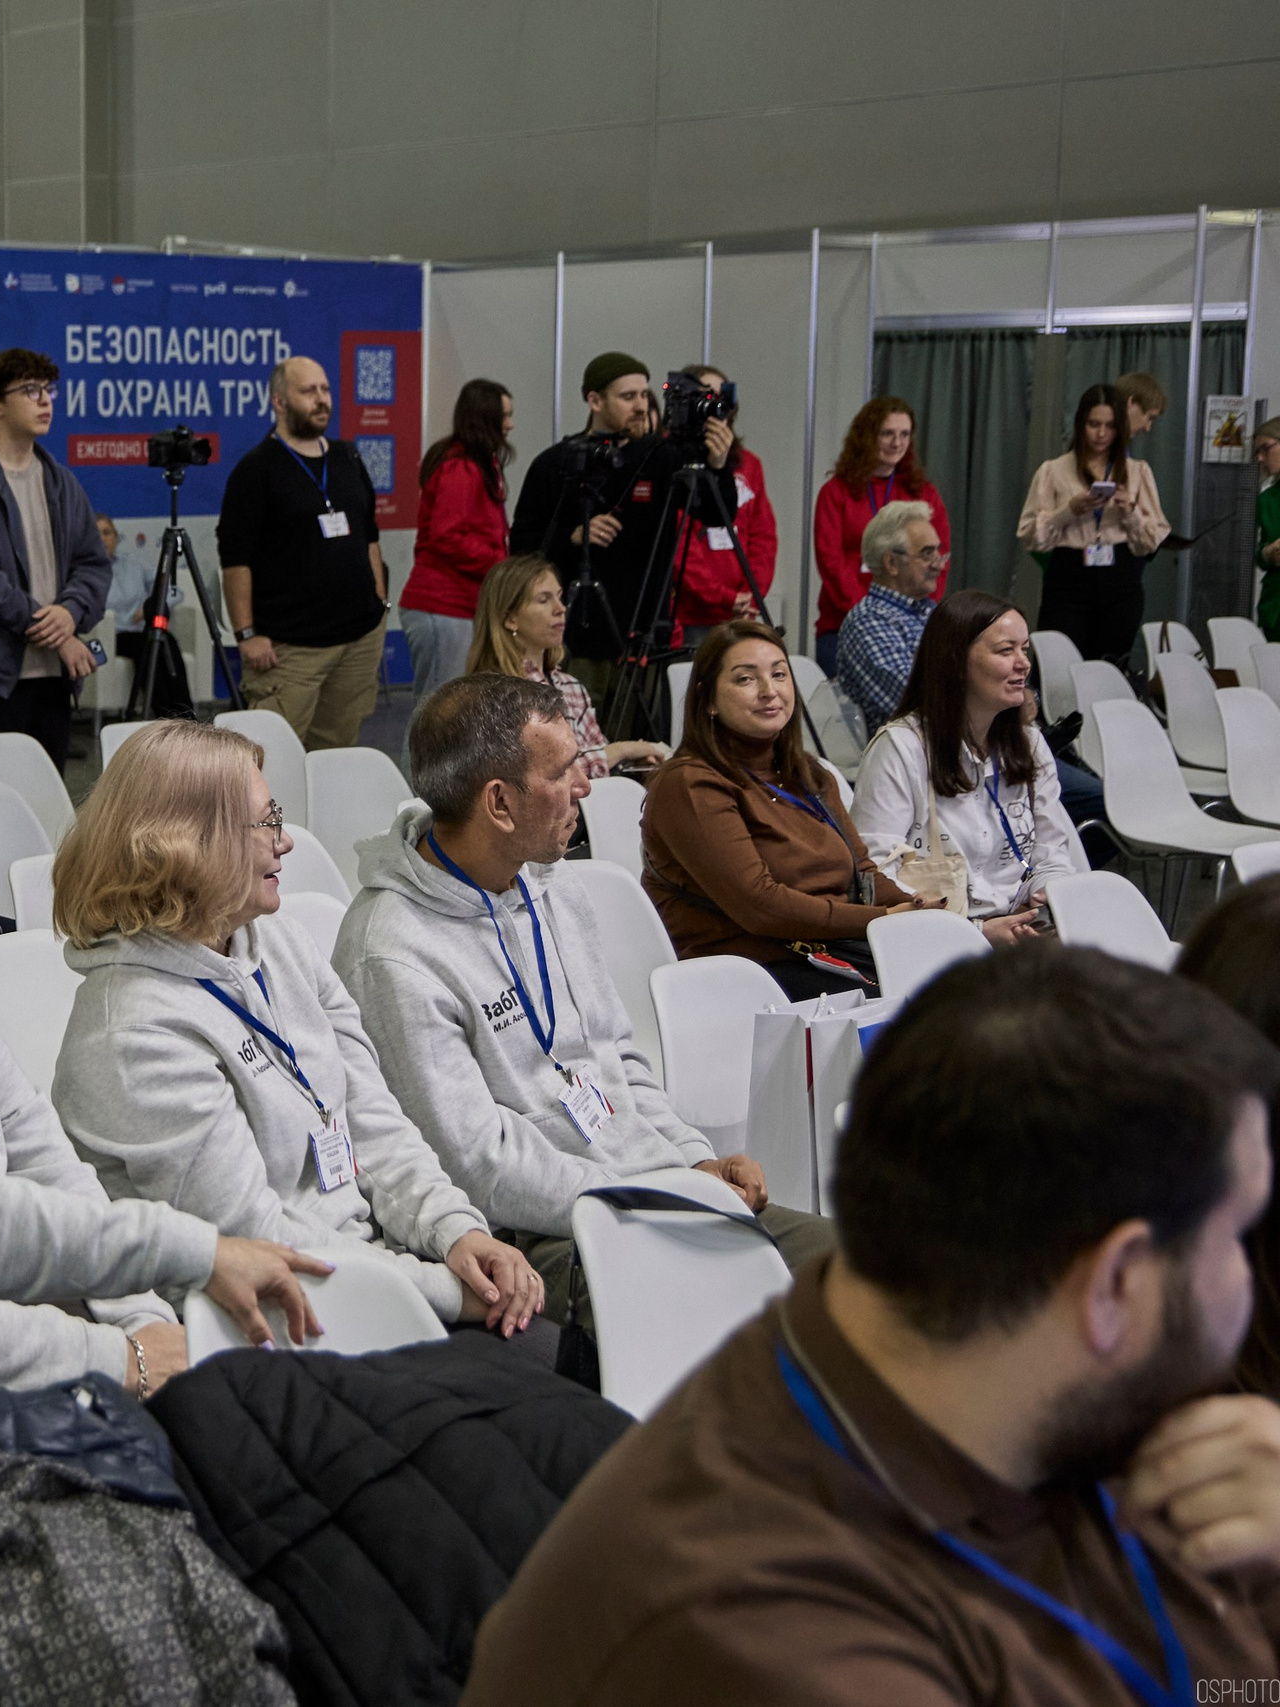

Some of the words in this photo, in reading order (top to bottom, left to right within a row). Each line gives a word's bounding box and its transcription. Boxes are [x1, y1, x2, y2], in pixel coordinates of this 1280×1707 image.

[66, 324, 292, 365] БЕЗОПАСНОСТЬ
[67, 379, 86, 417] И
[97, 378, 212, 418] ОХРАНА
[220, 380, 276, 422] ТРУ
[76, 440, 141, 461] ЕЖЕГОДНО
